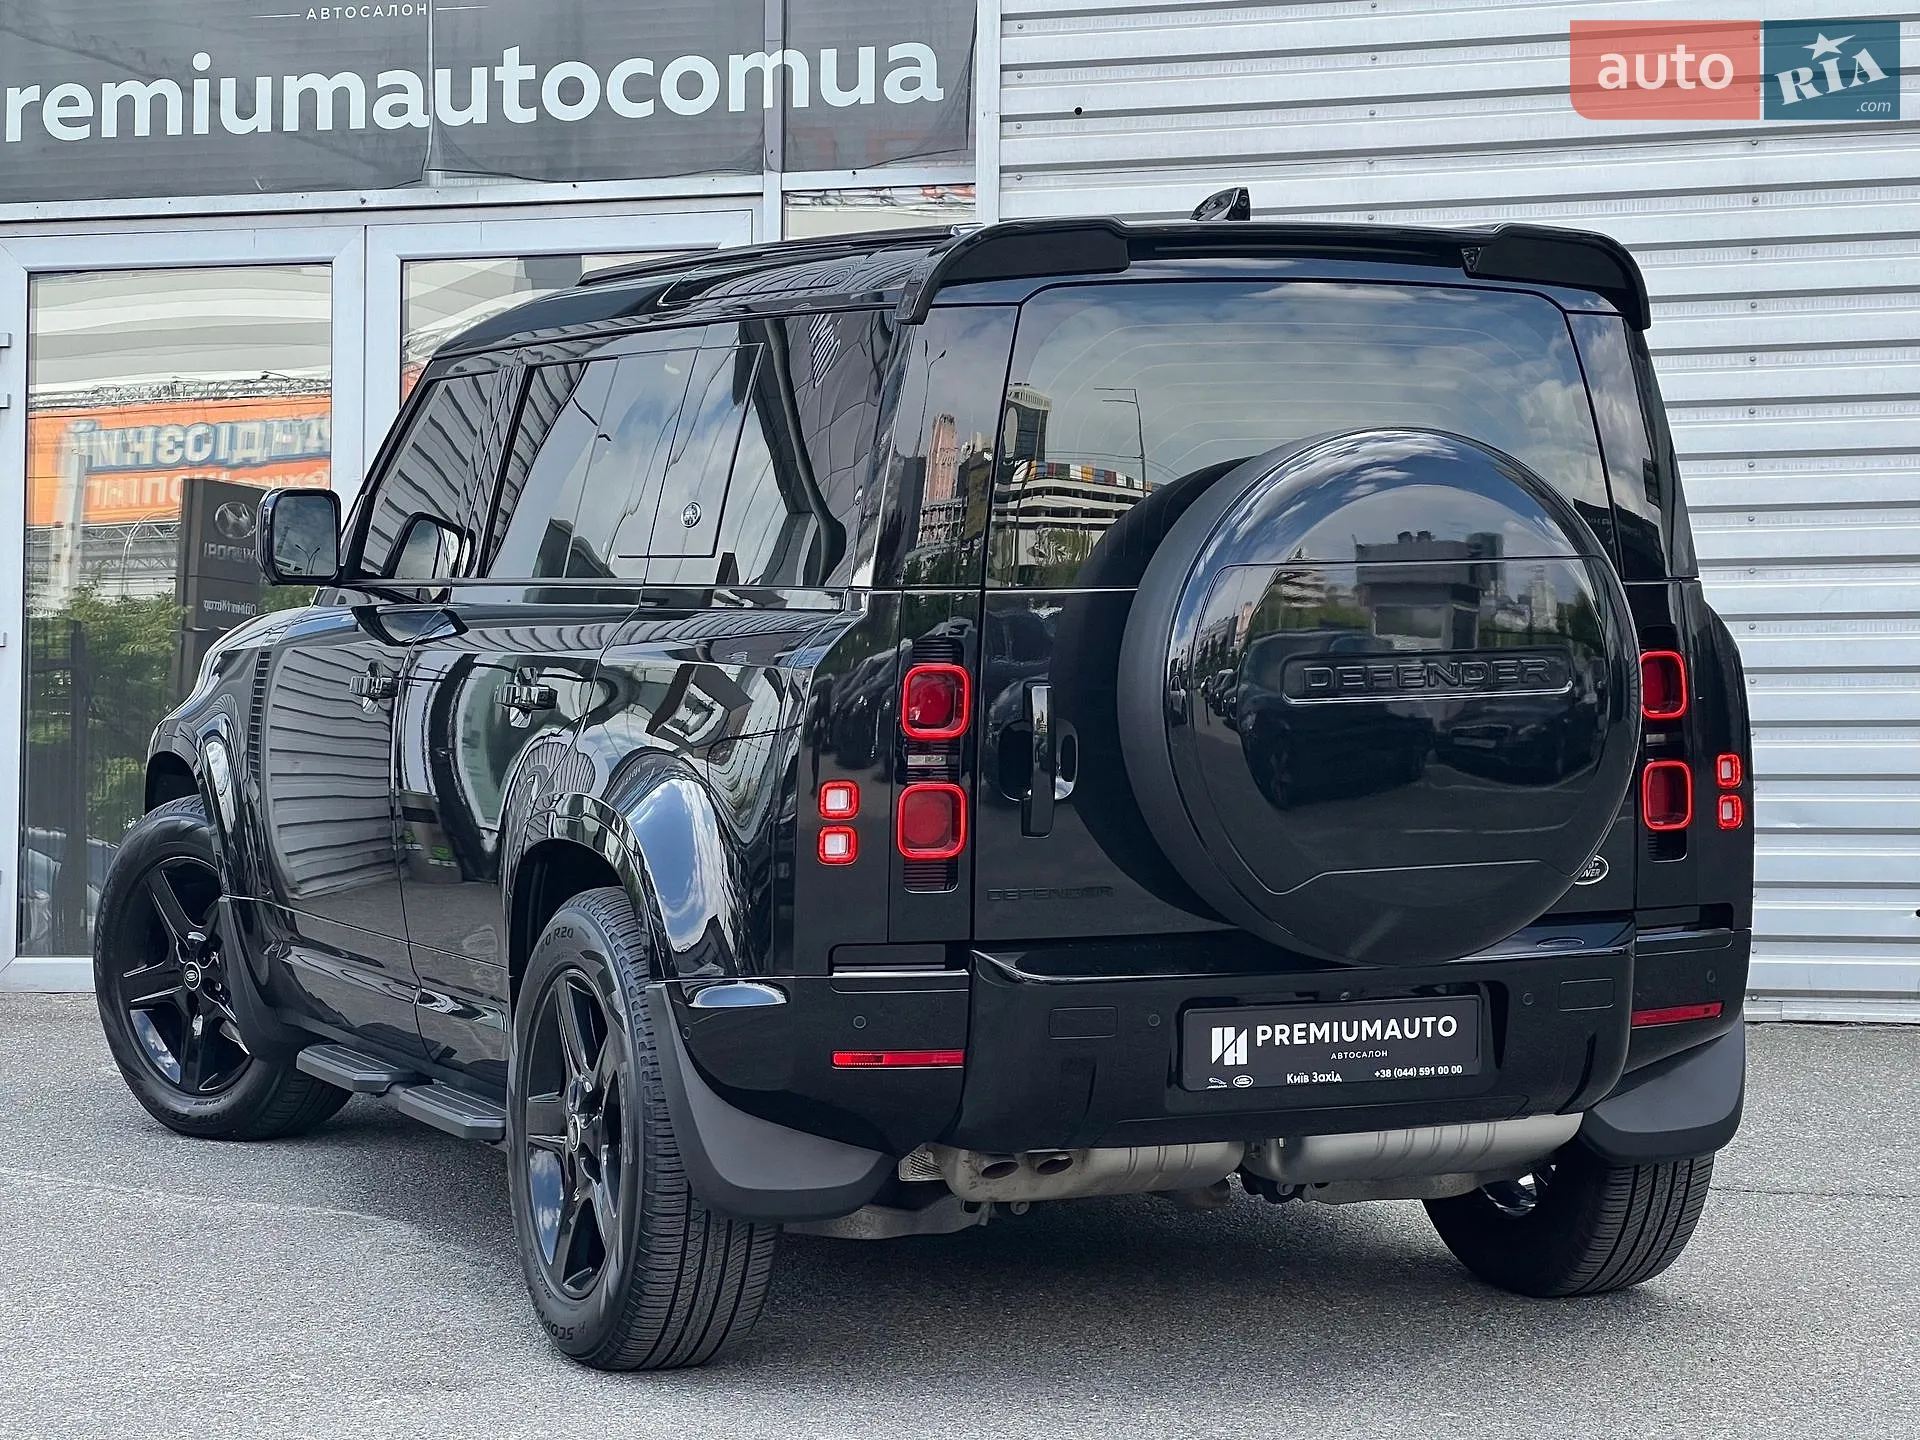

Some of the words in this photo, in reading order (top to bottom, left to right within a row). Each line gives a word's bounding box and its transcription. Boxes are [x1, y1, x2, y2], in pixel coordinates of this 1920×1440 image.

[306, 3, 428, 20] АВТОСАЛОН
[1302, 658, 1552, 693] DEFENDER
[986, 886, 1114, 900] DEFENDER
[554, 926, 574, 940] R20
[1256, 1015, 1458, 1047] PREMIUMAUTO
[1330, 1049, 1388, 1061] АВТОСАЛОН
[1286, 1072, 1310, 1085] Київ
[1311, 1070, 1343, 1084] Захід
[1374, 1068, 1392, 1078] +38
[1393, 1067, 1417, 1079] (044)
[1419, 1066, 1436, 1077] 591
[1437, 1066, 1449, 1076] 00
[1450, 1065, 1463, 1075] 00
